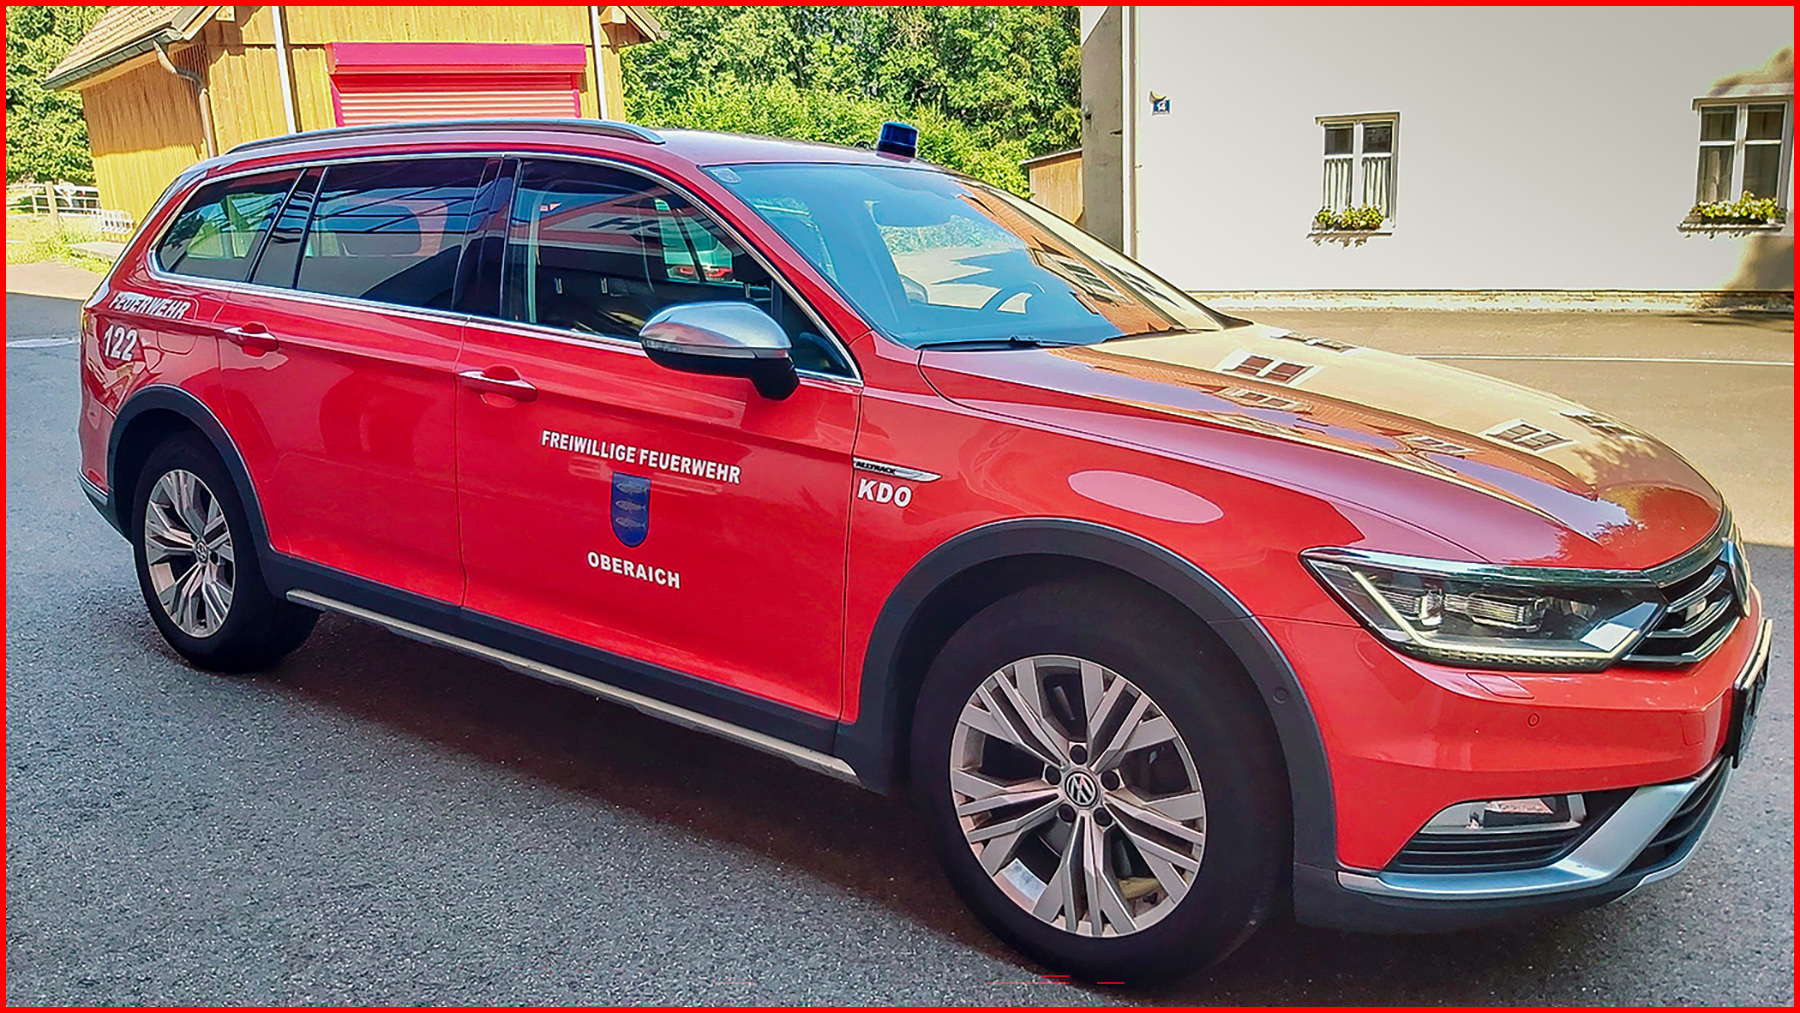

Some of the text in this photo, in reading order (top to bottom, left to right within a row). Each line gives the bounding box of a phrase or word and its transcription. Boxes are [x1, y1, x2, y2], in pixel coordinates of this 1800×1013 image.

[109, 292, 191, 320] FEUERWEHR
[104, 325, 138, 361] 122
[541, 430, 741, 484] FREIWILLIGE FEUERWEHR
[857, 478, 912, 508] KDO
[587, 551, 681, 589] OBERAICH
